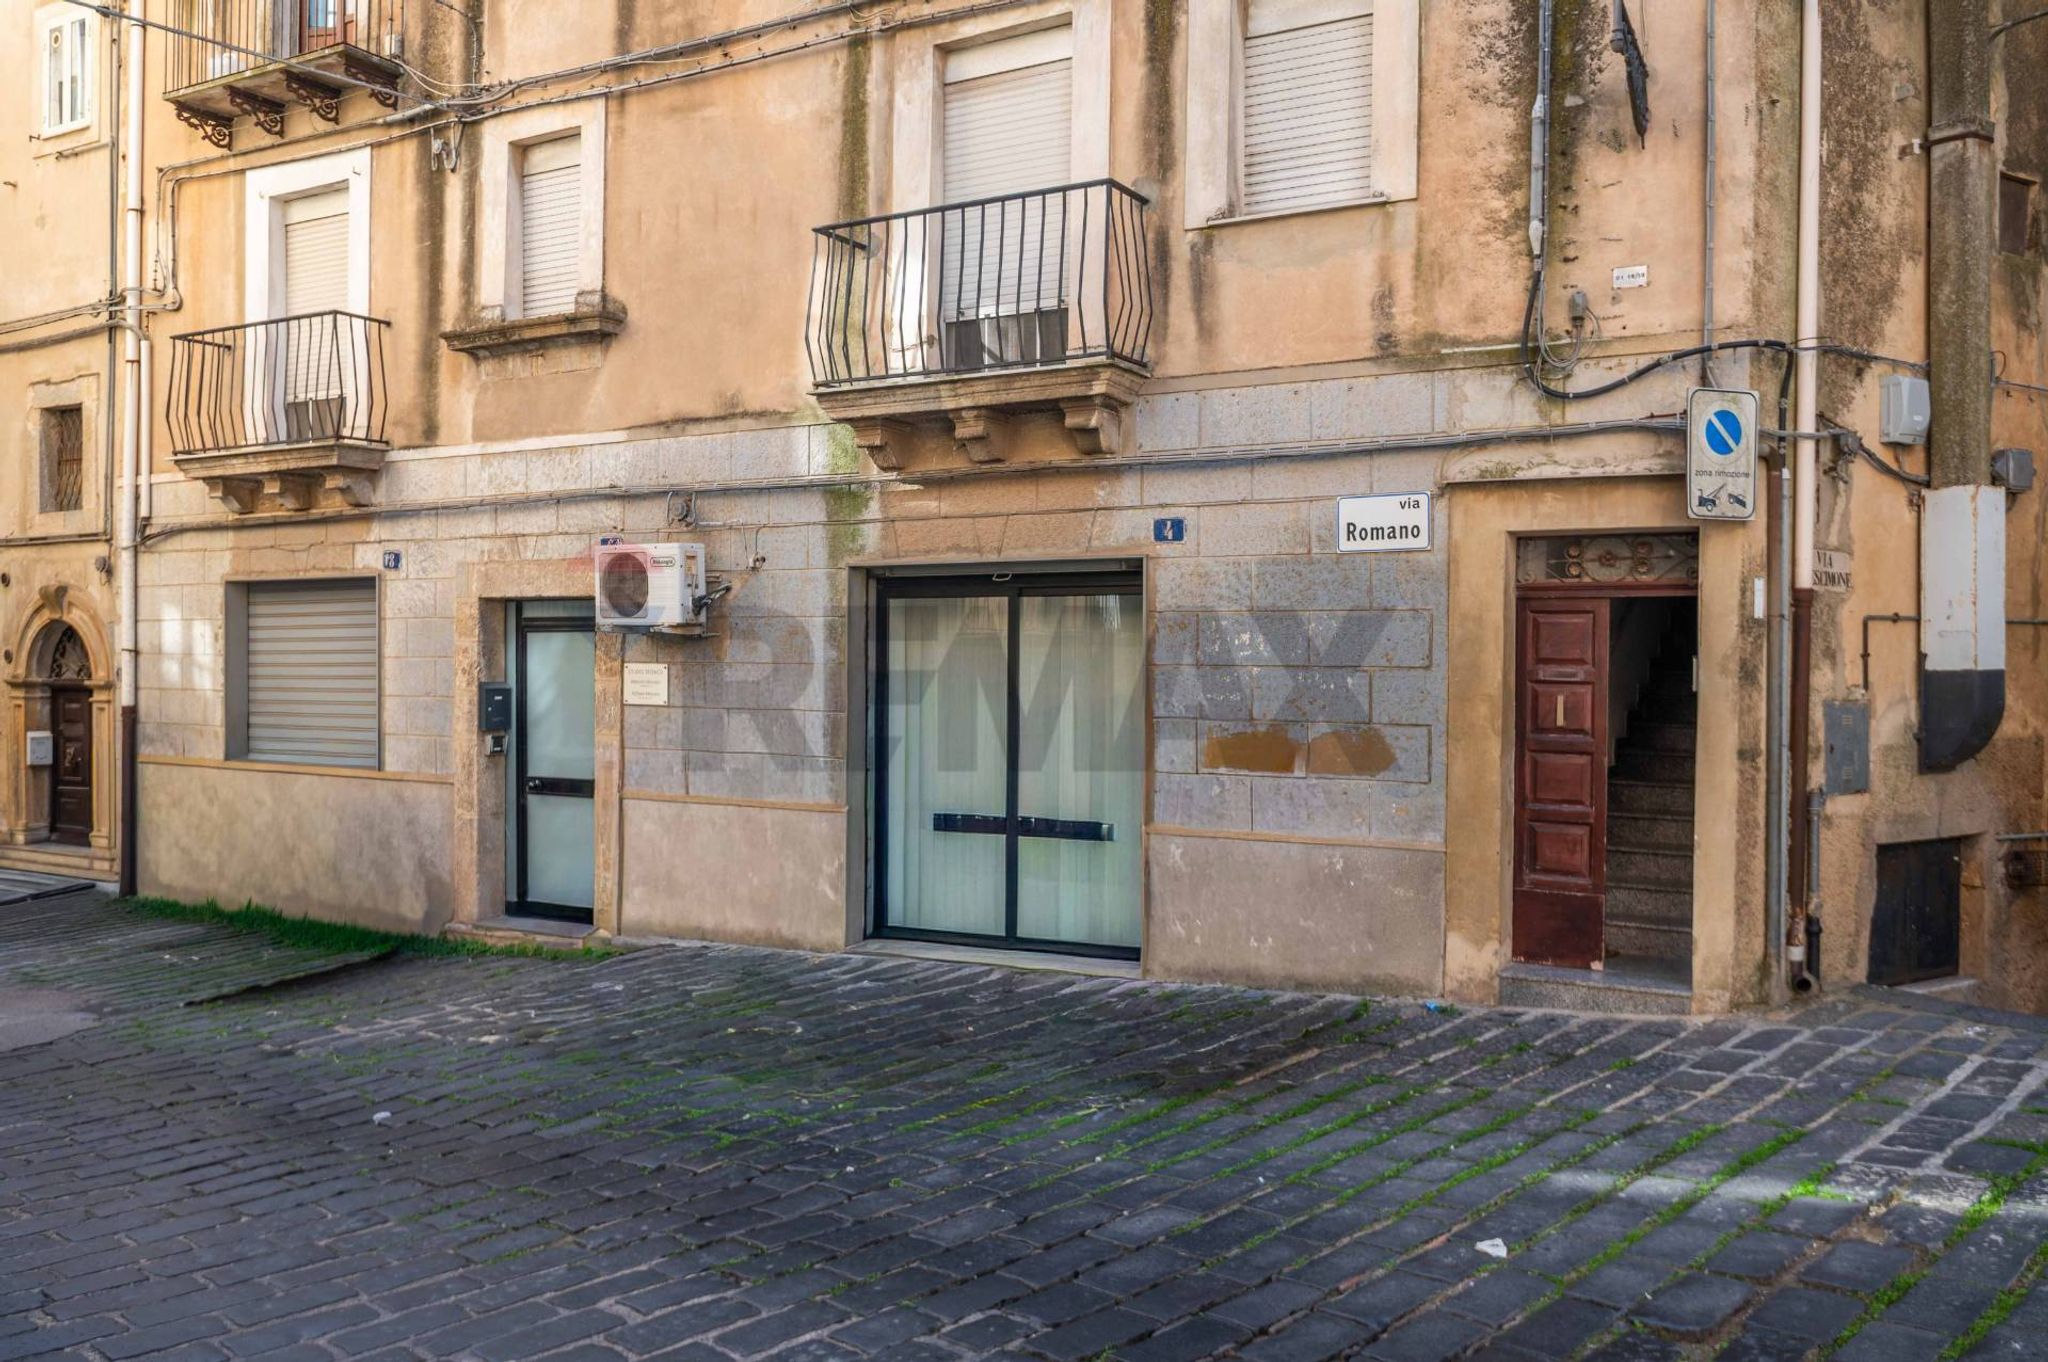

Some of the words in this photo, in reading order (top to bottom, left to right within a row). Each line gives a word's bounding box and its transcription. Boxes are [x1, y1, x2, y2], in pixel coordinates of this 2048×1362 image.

[1695, 469, 1712, 477] zona
[1715, 469, 1750, 479] rimozione
[1400, 497, 1421, 510] via
[1346, 522, 1421, 542] Romano
[1816, 549, 1833, 570] VIA
[1812, 569, 1854, 590] SCIMONE
